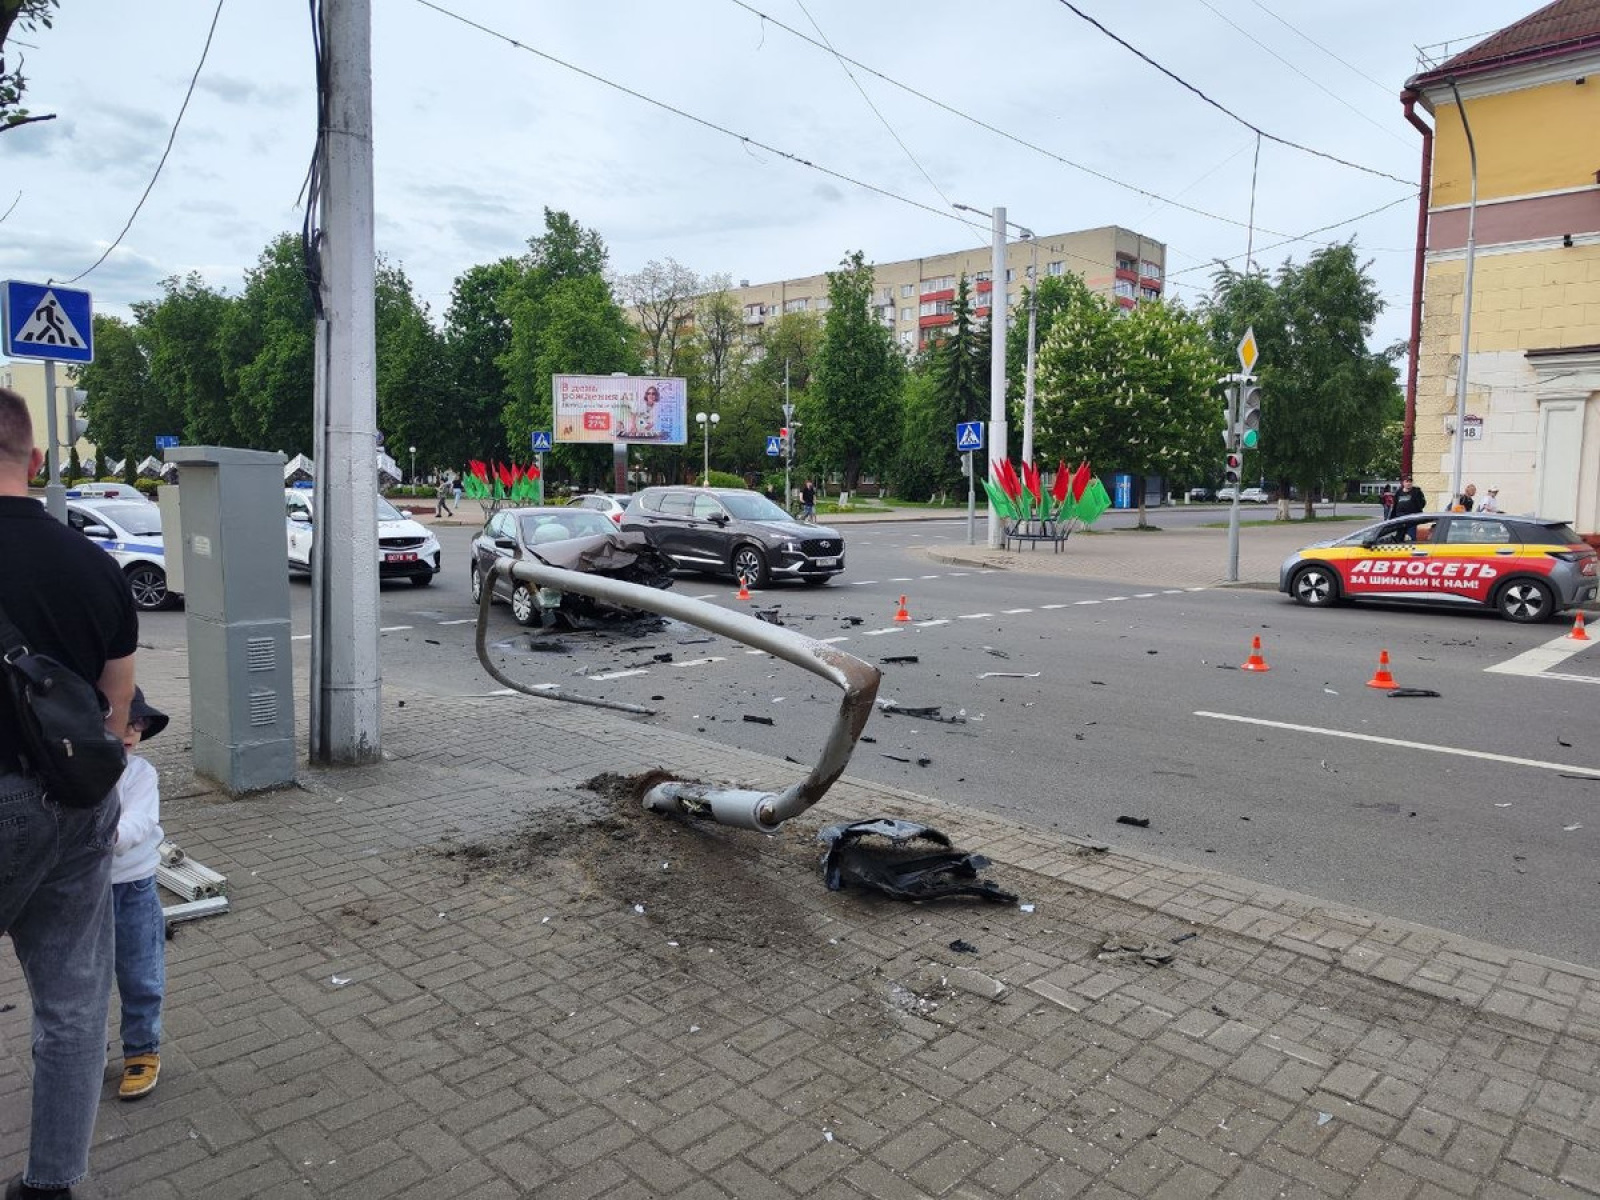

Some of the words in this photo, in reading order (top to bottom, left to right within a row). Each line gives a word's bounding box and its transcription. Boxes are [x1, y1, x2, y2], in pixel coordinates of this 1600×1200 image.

[1464, 427, 1476, 438] 18
[1351, 559, 1497, 578] АВТОСЕТЬ
[1350, 575, 1366, 584] ЗА
[1369, 576, 1429, 586] ШИНАМИ
[1432, 578, 1441, 587] К
[1444, 579, 1479, 589] НАМ!
